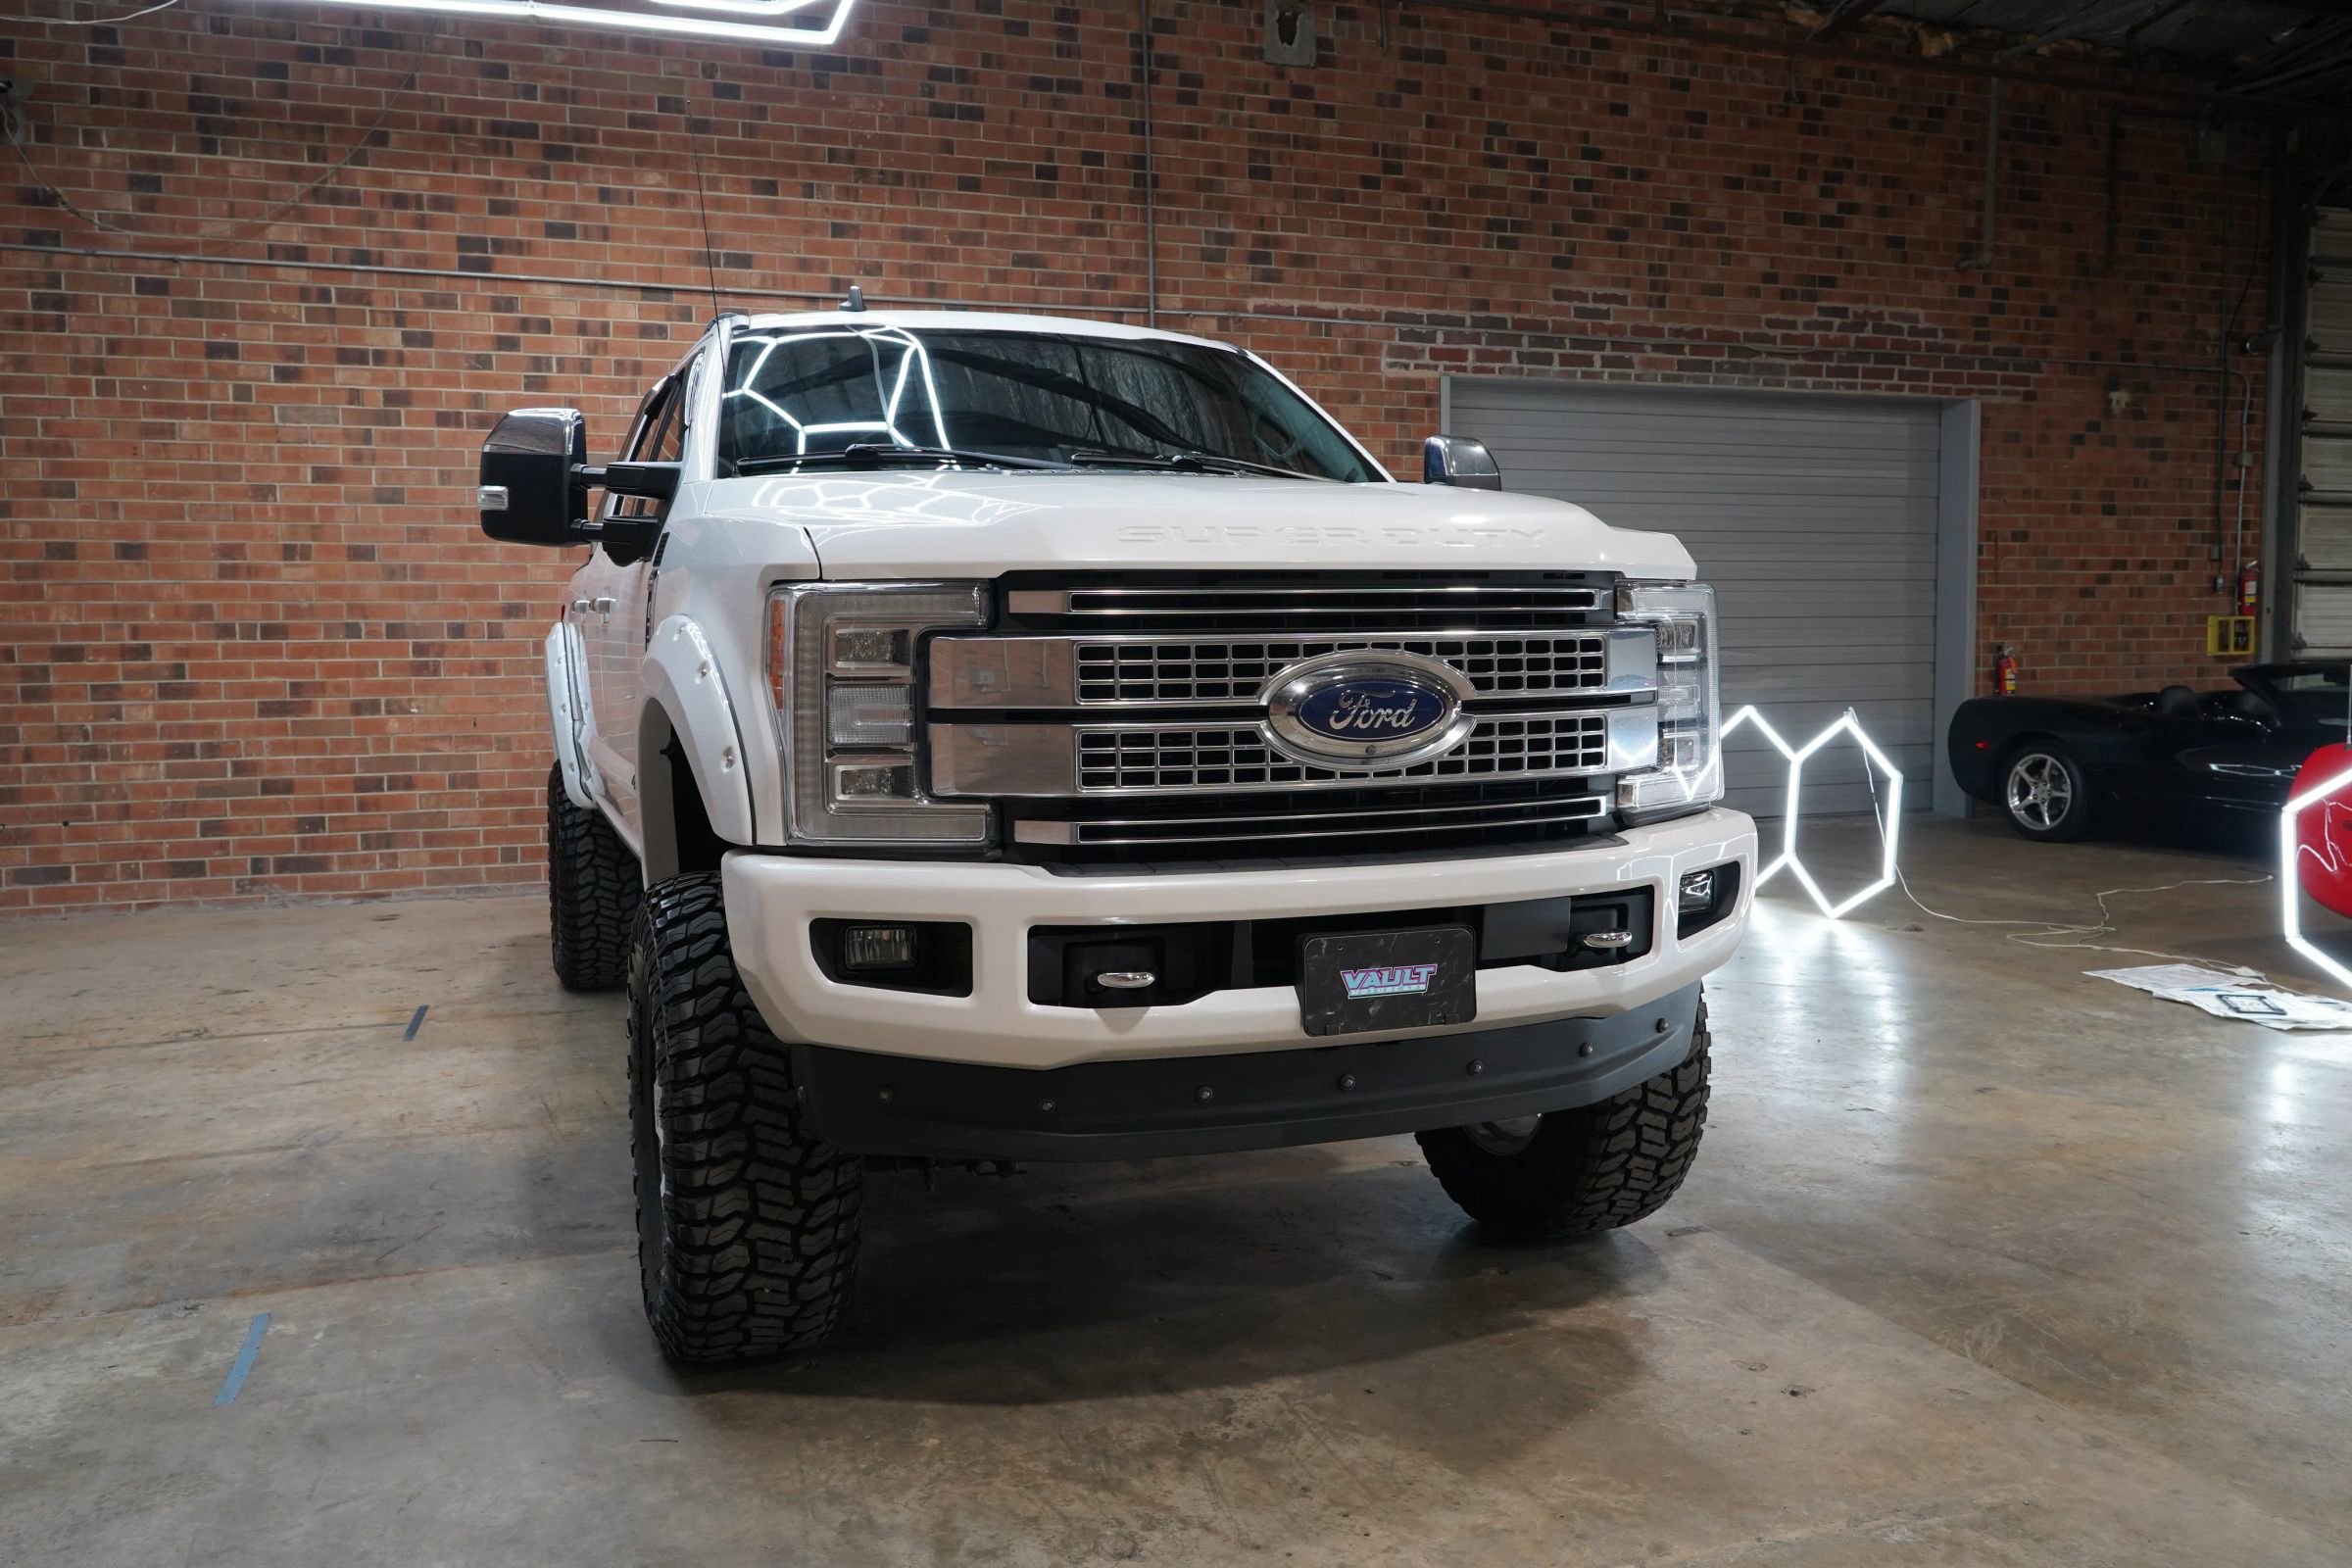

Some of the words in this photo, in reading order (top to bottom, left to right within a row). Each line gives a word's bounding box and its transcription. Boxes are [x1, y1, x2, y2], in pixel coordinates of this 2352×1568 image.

[1116, 525, 1369, 547] SUPER
[1381, 526, 1546, 548] DUTY
[1329, 689, 1417, 730] Ford
[1342, 964, 1437, 990] VAULT
